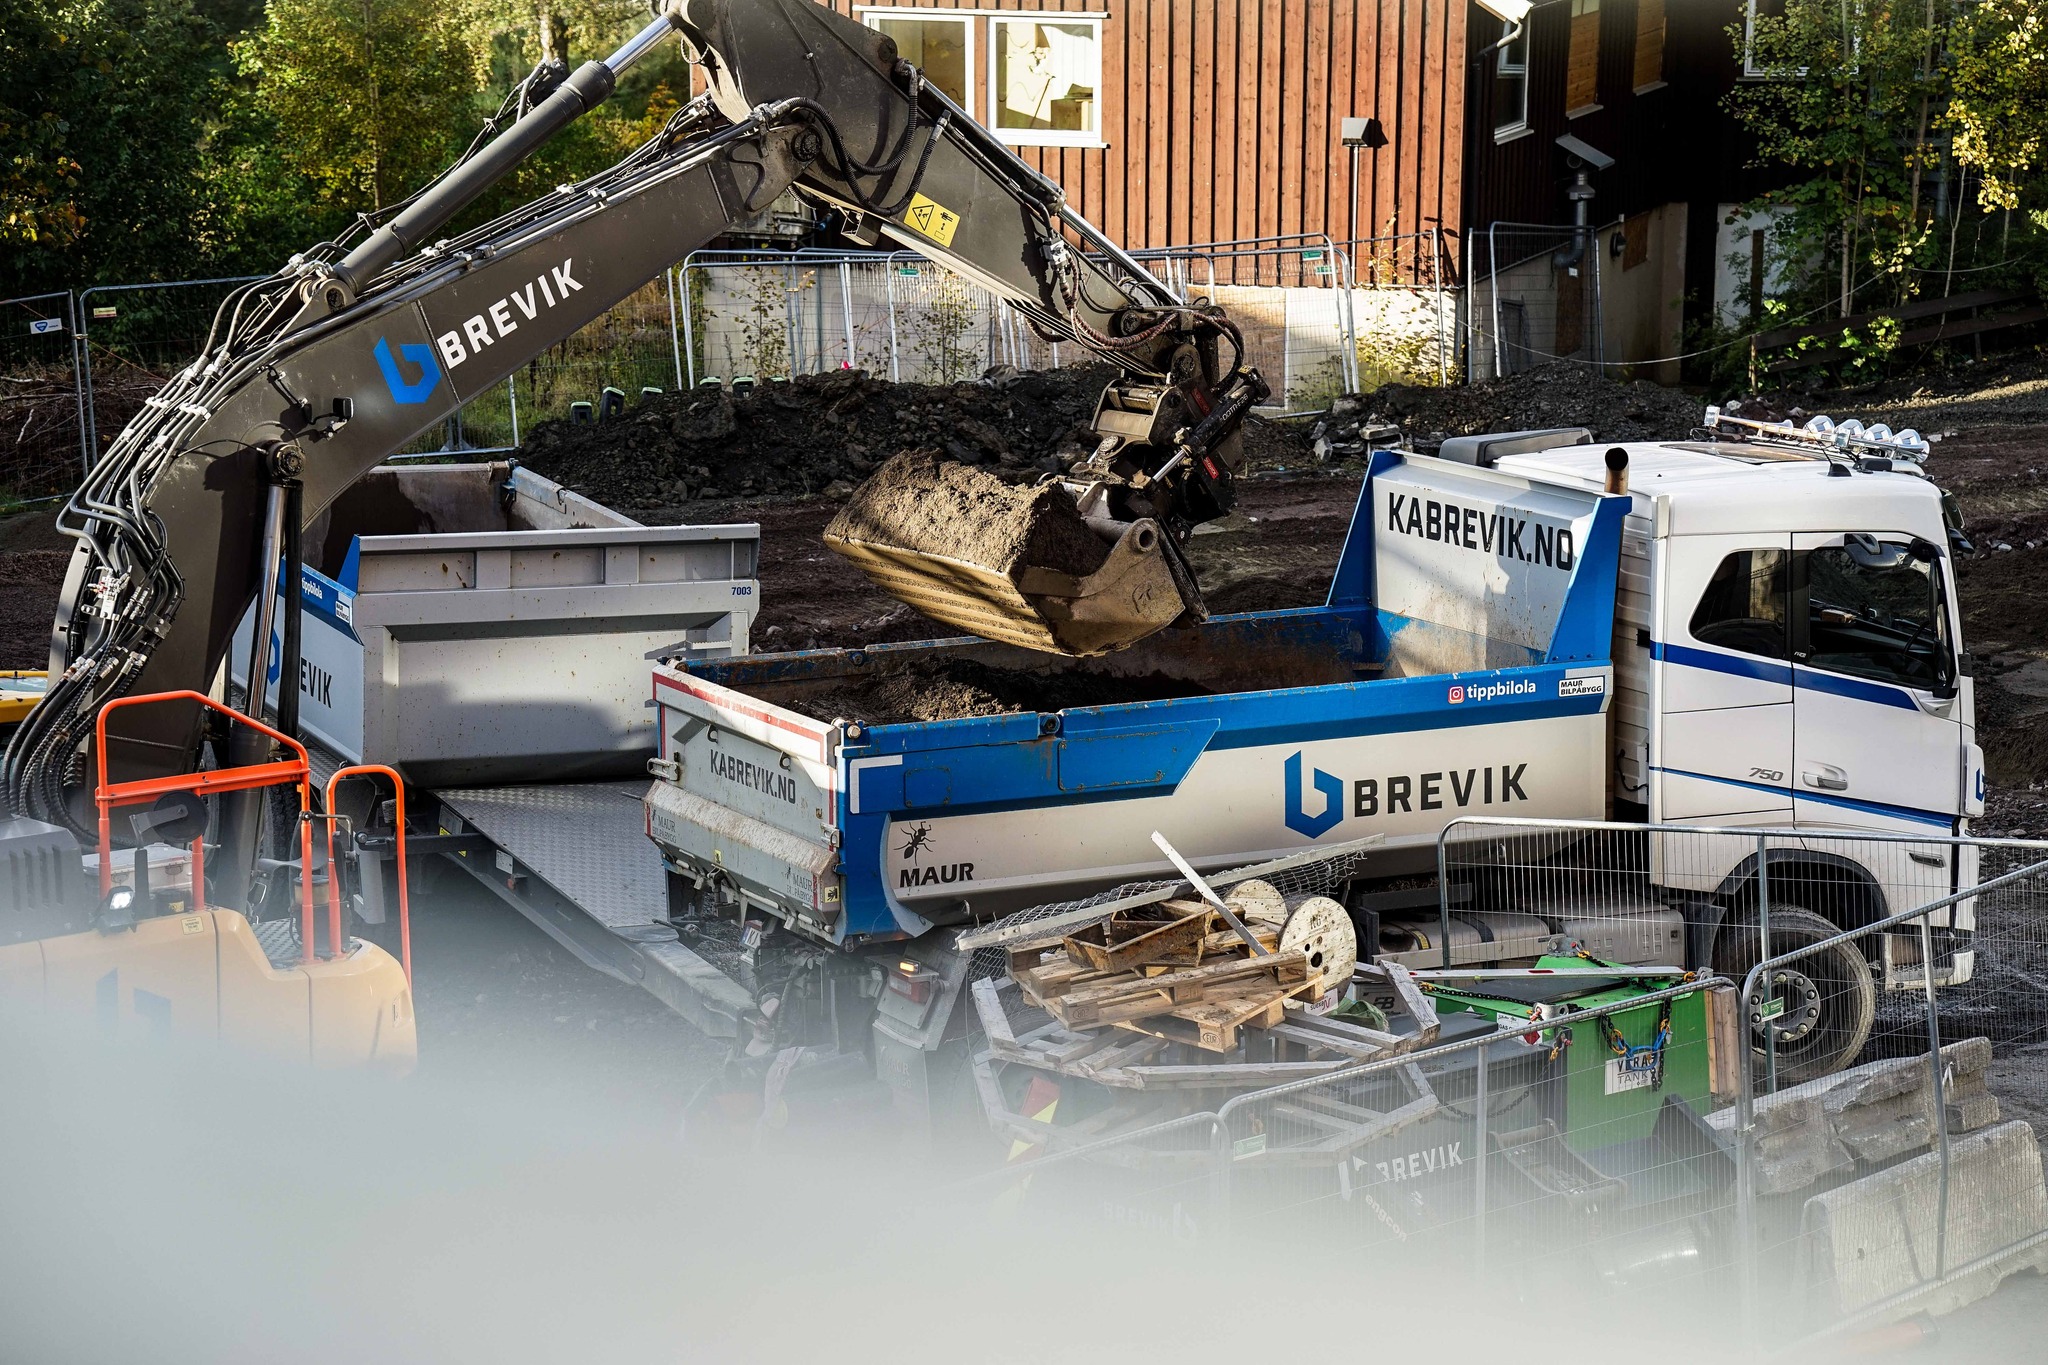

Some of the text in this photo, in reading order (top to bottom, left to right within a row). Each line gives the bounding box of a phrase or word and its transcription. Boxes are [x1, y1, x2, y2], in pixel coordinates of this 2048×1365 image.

[437, 257, 584, 369] BREVIK
[1389, 492, 1573, 571] KABREVIK.NO
[731, 586, 752, 596] 7003
[300, 656, 332, 709] EVIK
[1467, 679, 1536, 701] tippbilola
[1560, 679, 1583, 688] MAUR
[1560, 685, 1602, 696] BILPÅBYGG
[710, 749, 796, 804] KABREVIK.NO
[1749, 767, 1784, 782] 750
[1354, 763, 1529, 818] BREVIK
[657, 815, 676, 833] MAUR
[793, 873, 813, 893] MAUR
[900, 862, 974, 888] MAUR
[1617, 1070, 1648, 1084] TANK
